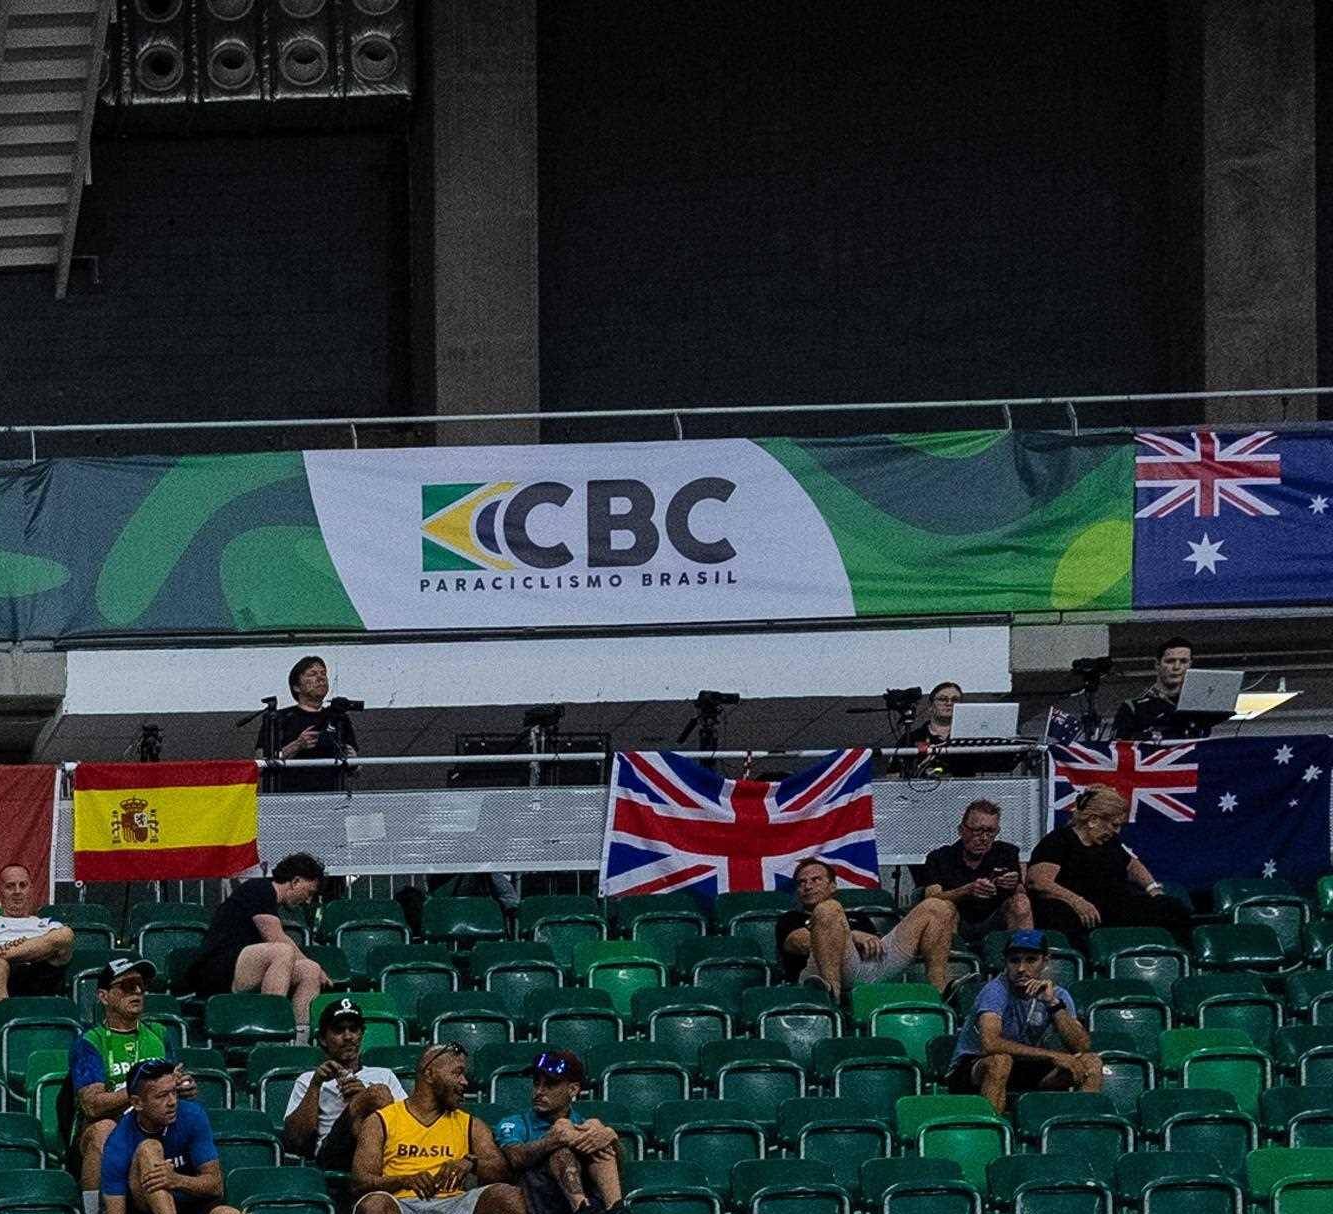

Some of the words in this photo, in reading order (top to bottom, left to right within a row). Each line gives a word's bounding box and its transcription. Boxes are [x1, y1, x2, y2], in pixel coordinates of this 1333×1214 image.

[502, 476, 737, 569] CBC
[420, 573, 623, 593] PARACICLISMO
[641, 570, 737, 587] BRASIL
[396, 1143, 454, 1158] BRASIL
